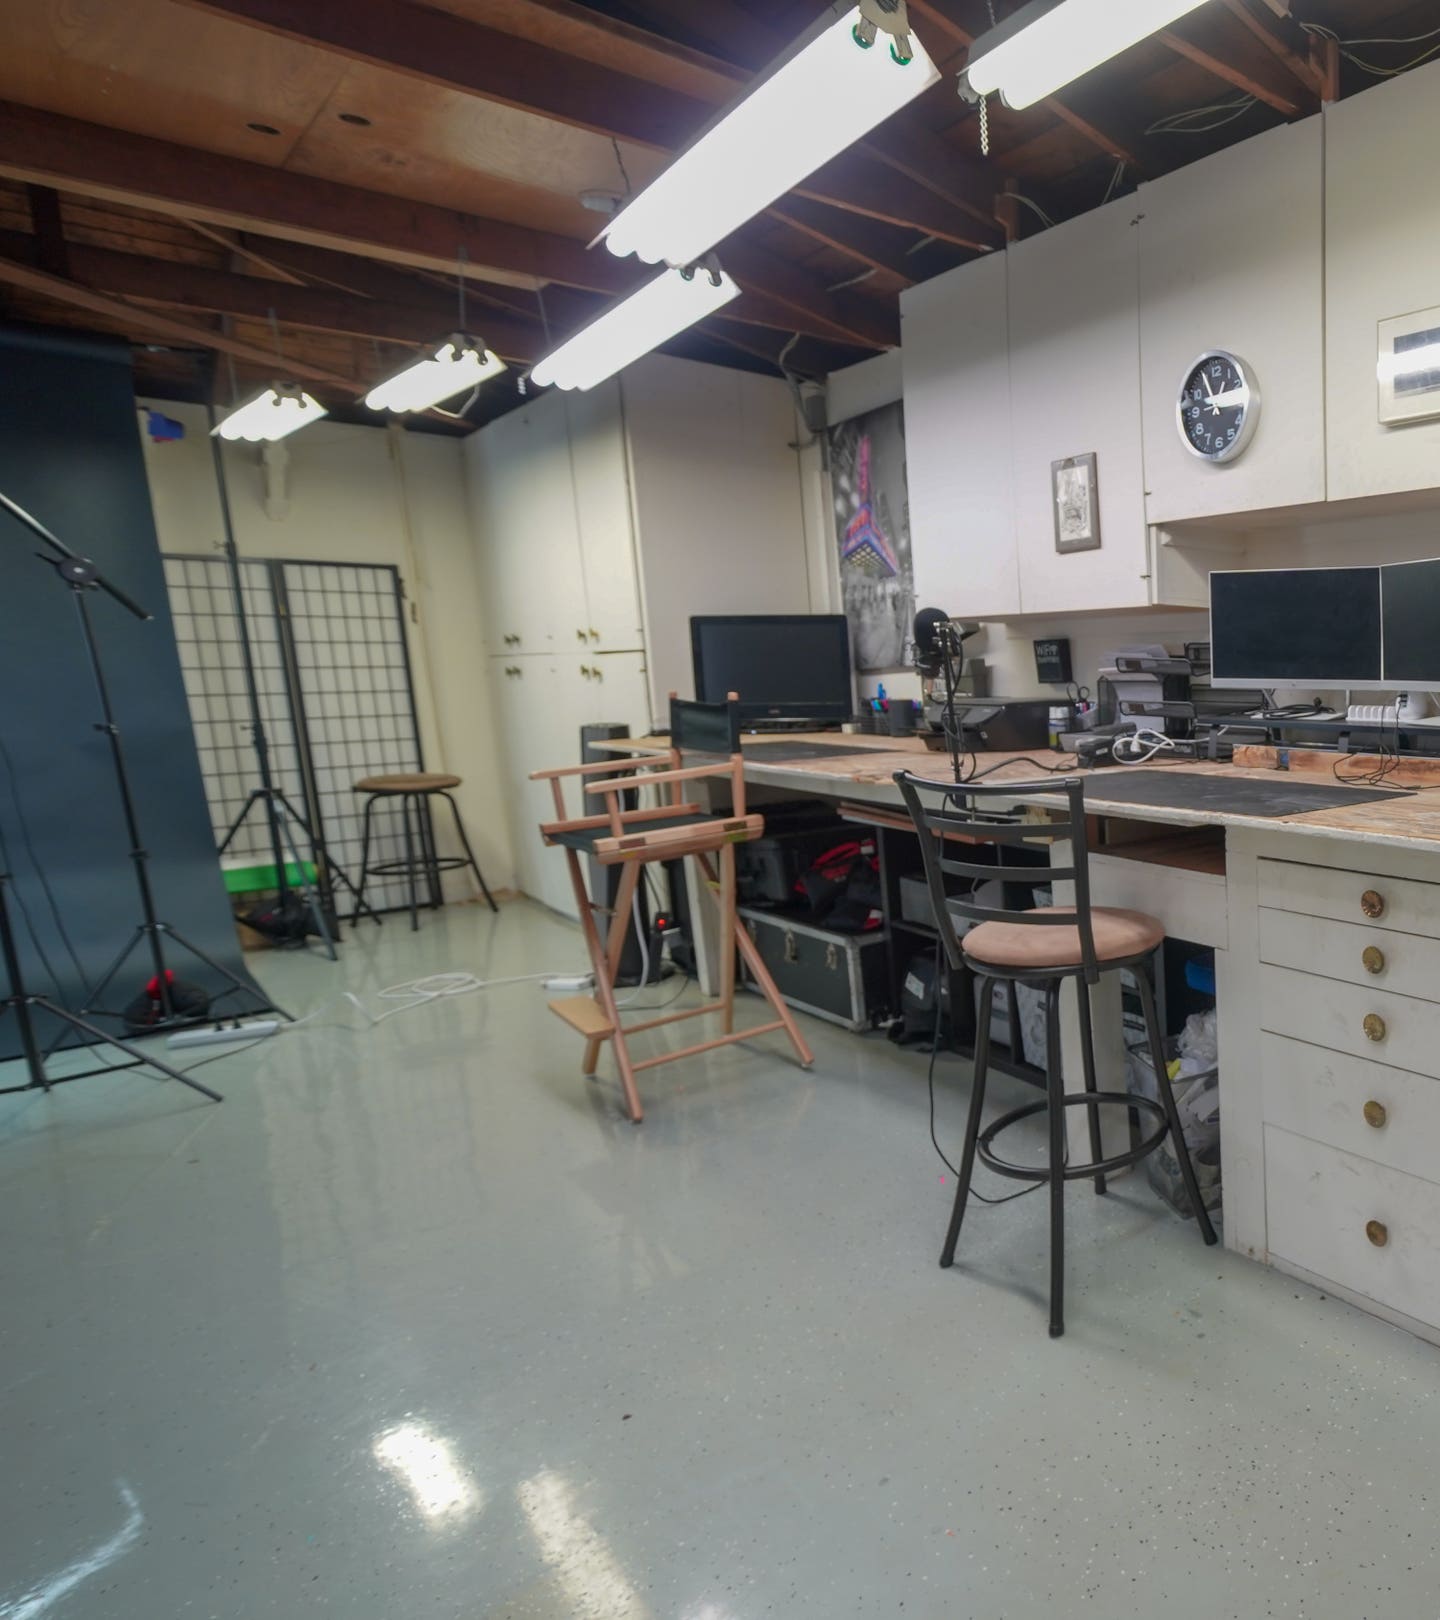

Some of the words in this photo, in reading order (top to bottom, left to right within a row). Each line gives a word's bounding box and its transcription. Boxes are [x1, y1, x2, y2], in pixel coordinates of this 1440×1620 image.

[1211, 365, 1222, 378] 12
[1233, 379, 1242, 389] 2
[1193, 389, 1202, 401] 10
[1191, 406, 1200, 418] 9
[1235, 414, 1242, 425] 4
[1195, 422, 1204, 435] 8
[1227, 428, 1235, 440] 5
[1204, 433, 1211, 445] 7
[1215, 437, 1223, 448] 6
